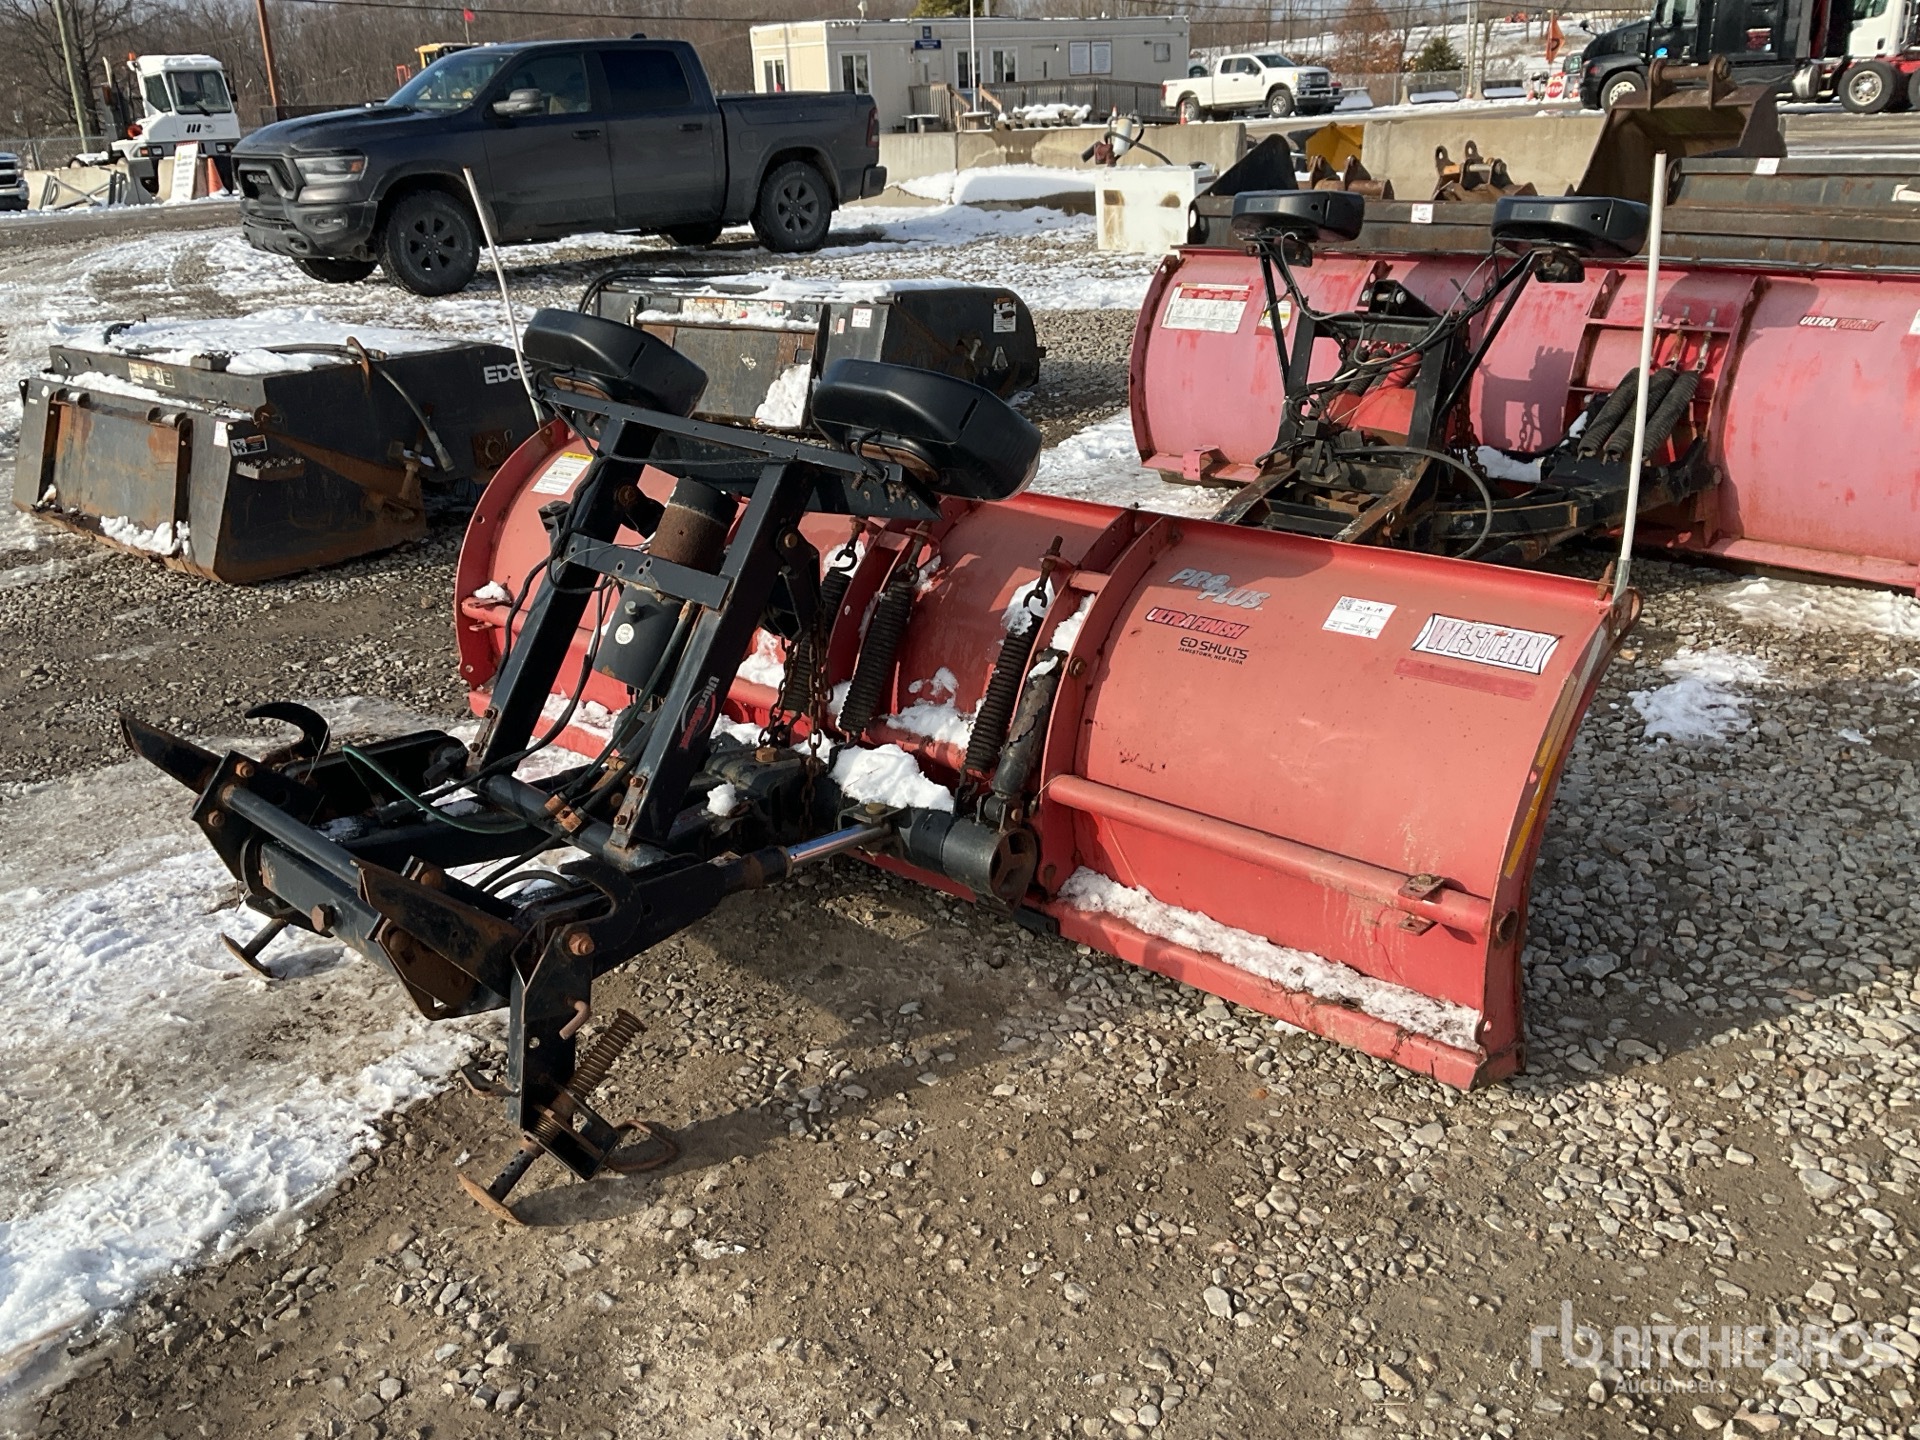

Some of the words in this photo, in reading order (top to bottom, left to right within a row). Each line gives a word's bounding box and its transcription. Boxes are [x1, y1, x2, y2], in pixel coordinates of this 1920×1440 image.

[1799, 315, 1838, 328] ULTRA
[483, 360, 534, 385] EDGE
[1168, 568, 1230, 590] PRO
[1197, 584, 1270, 609] PLUS
[1145, 607, 1197, 630] ULTRA
[1192, 616, 1249, 640] FINISH
[1180, 636, 1198, 648] ED
[1199, 641, 1249, 660] SHULTS
[1425, 618, 1550, 668] WESTERN
[1178, 647, 1213, 659] JAMESTOWN,
[1228, 657, 1243, 666] YORK
